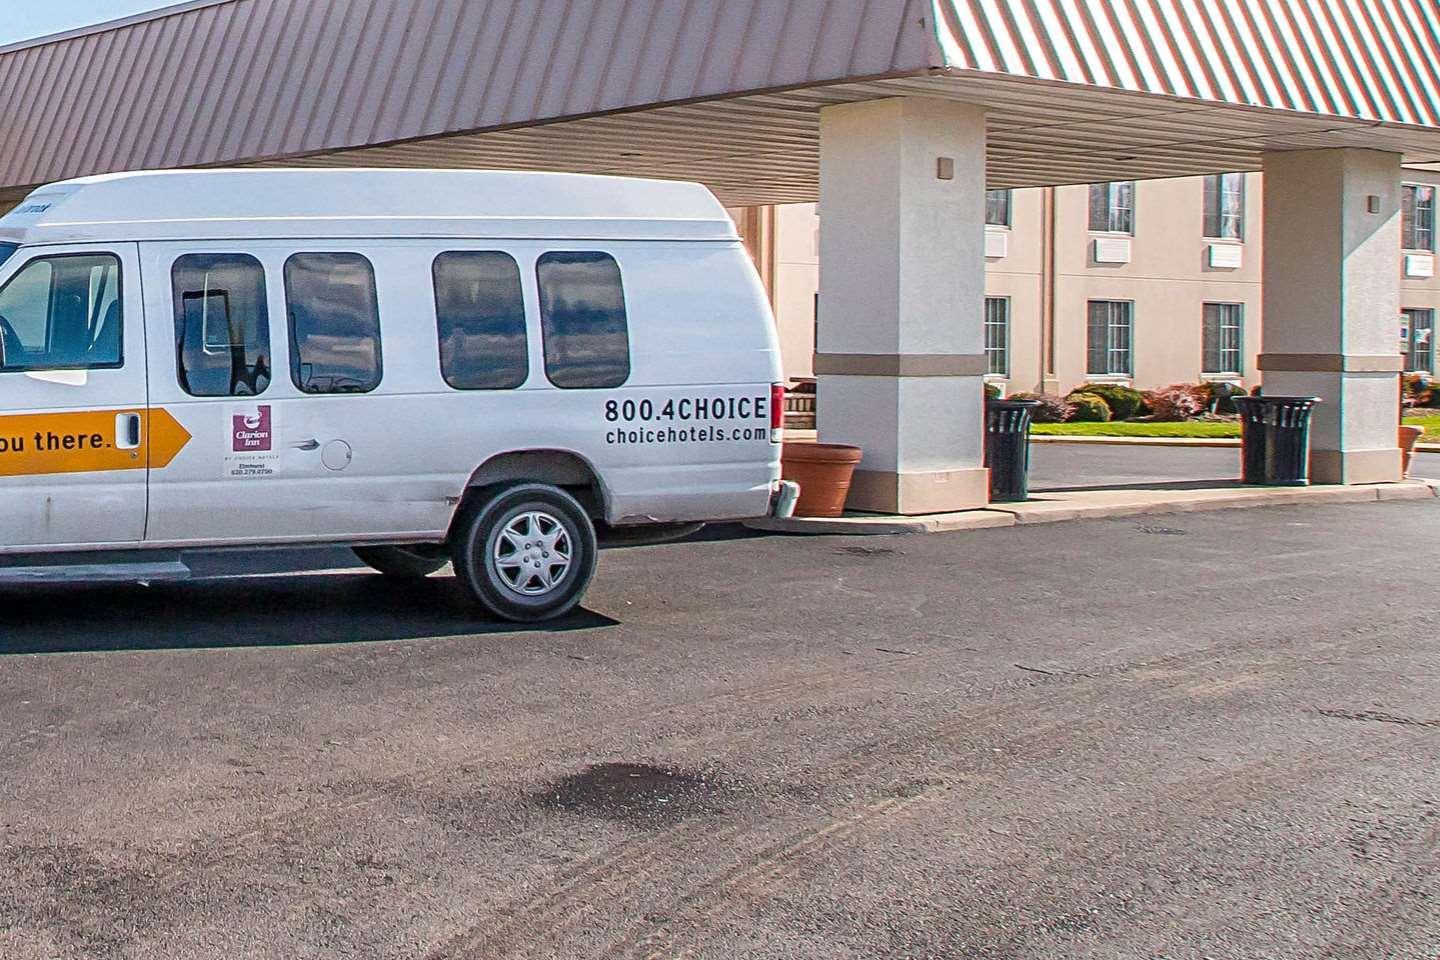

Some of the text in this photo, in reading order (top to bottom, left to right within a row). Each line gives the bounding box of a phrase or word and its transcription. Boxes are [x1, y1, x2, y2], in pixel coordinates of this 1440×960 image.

[605, 397, 767, 421] 800.4CHOICE
[35, 432, 112, 450] there.
[235, 430, 268, 439] Clarion
[606, 426, 766, 444] choicehotels.com
